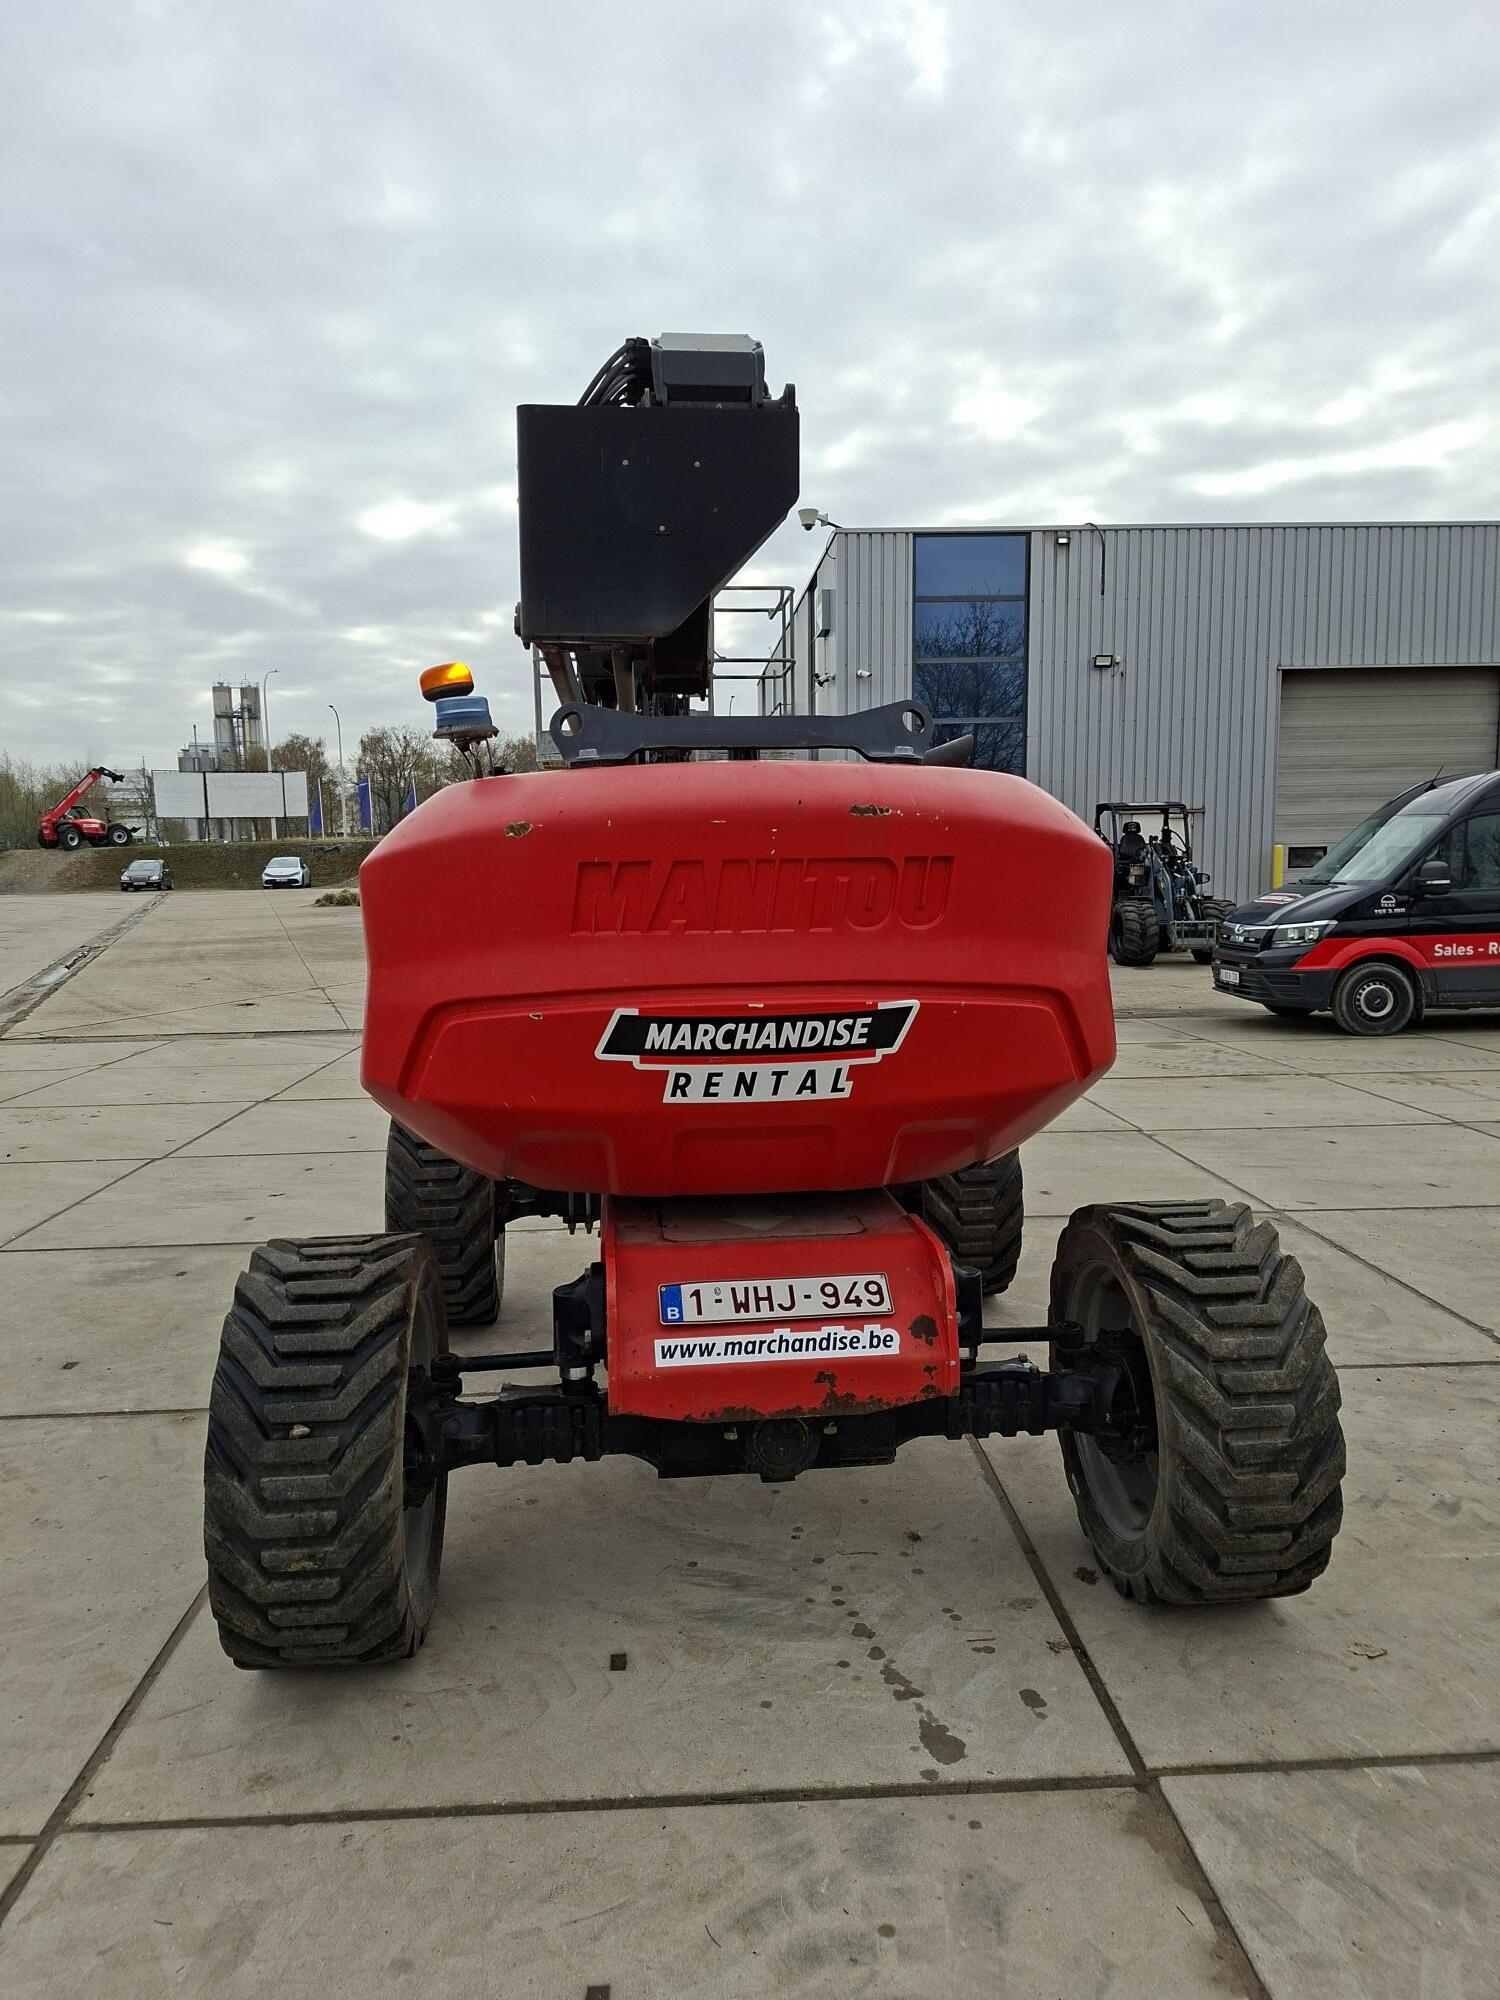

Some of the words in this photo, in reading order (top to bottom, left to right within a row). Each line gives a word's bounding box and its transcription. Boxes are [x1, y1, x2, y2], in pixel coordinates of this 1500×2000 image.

[571, 855, 955, 936] MANITOU
[1433, 943, 1474, 957] Sales
[1488, 941, 1500, 955] R
[644, 1017, 872, 1051] MARCHANDISE
[670, 1067, 847, 1098] RENTAL
[667, 1307, 680, 1320] B
[689, 1280, 885, 1316] 1-WHJ-949
[660, 1330, 894, 1360] www.marchandise.be
